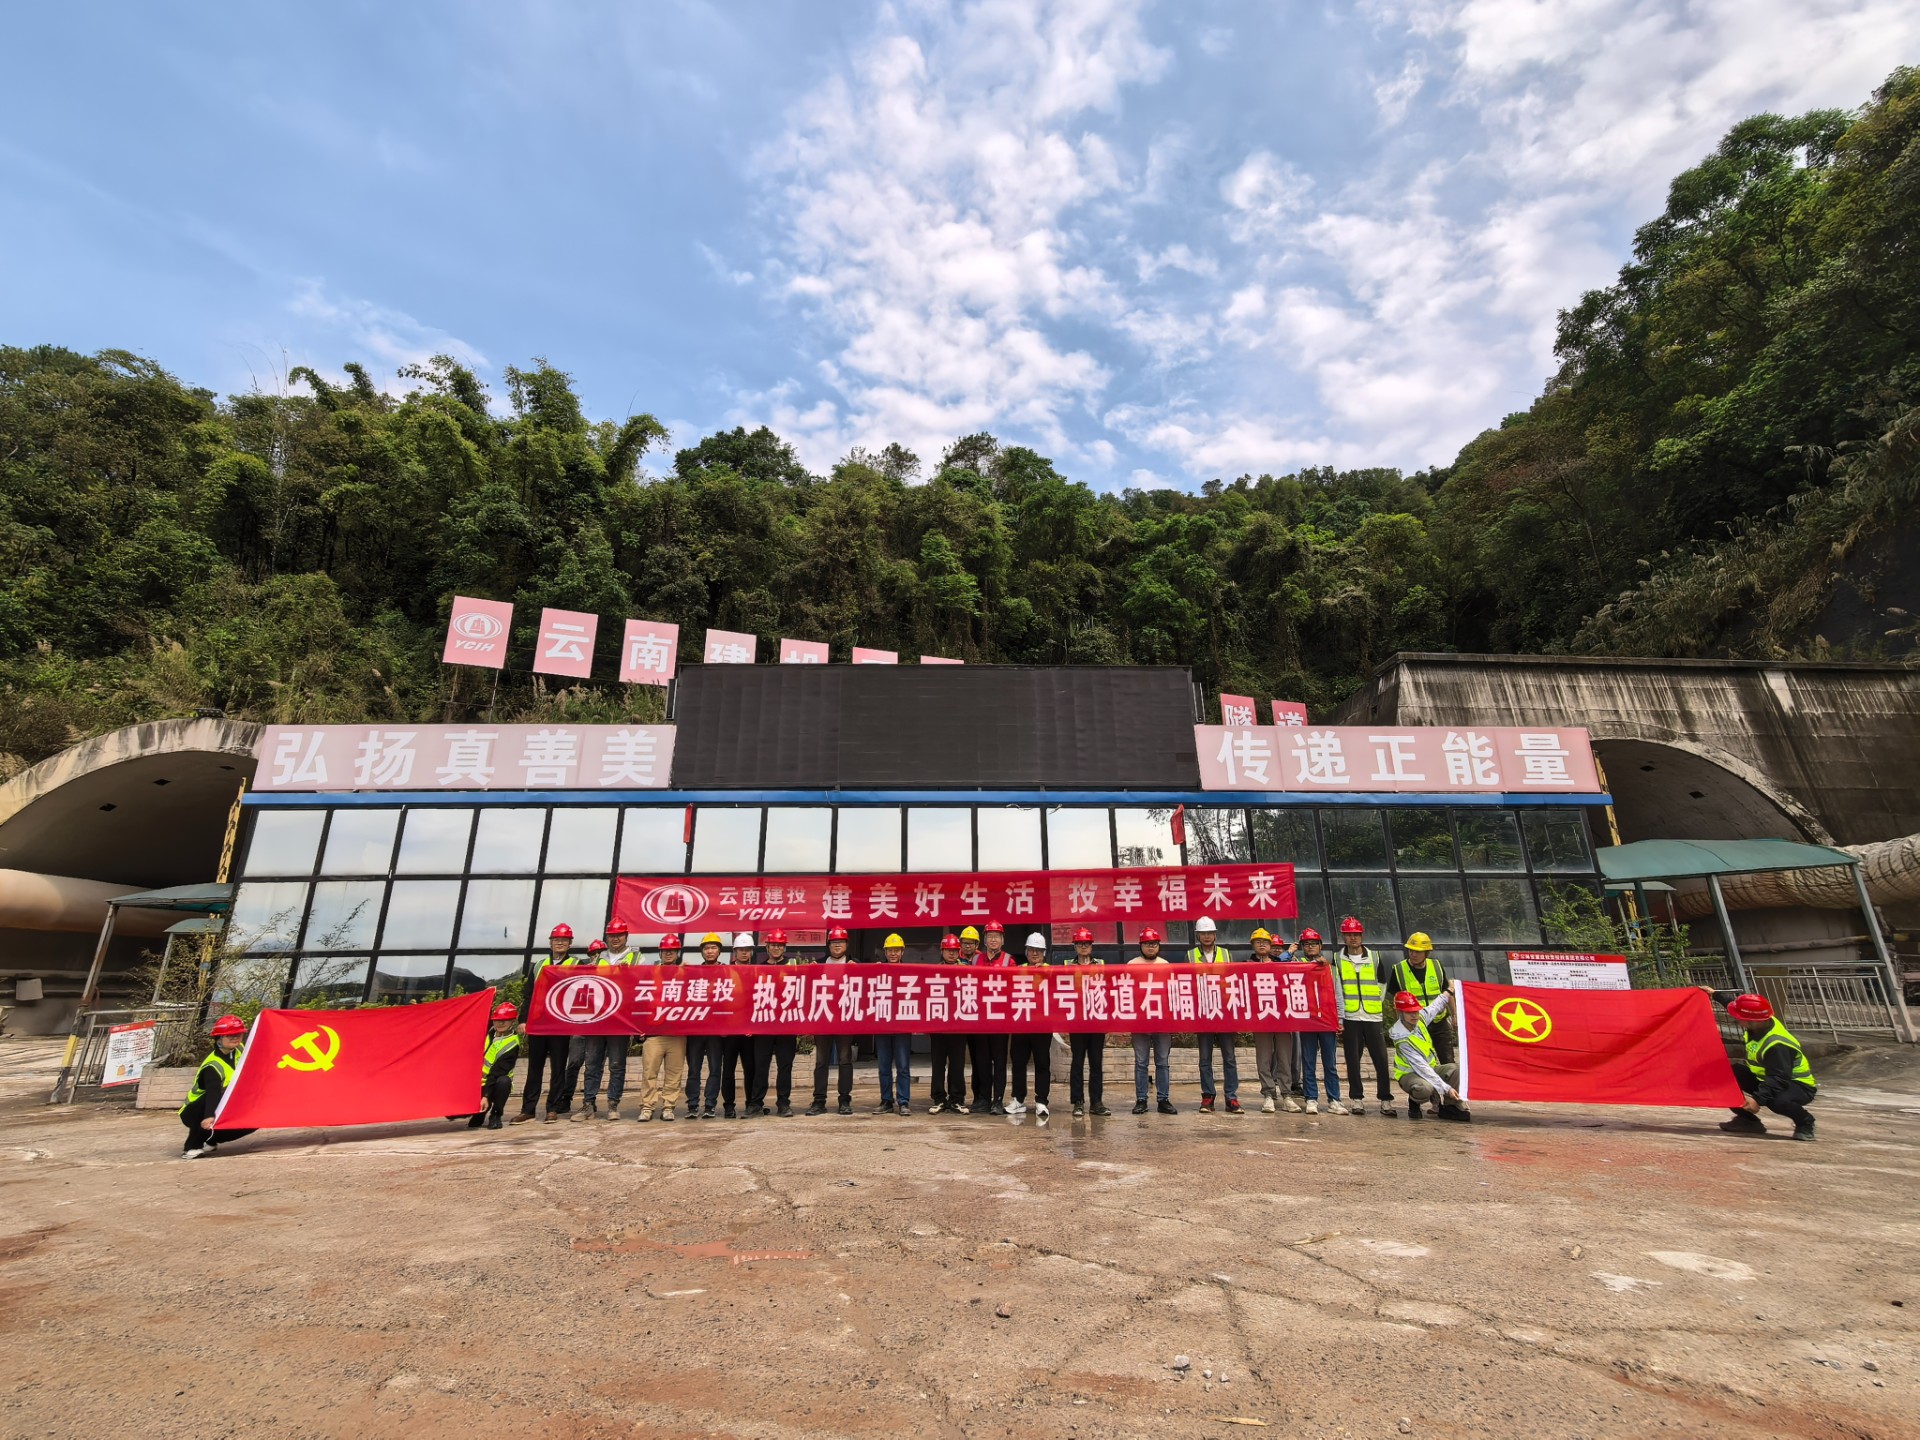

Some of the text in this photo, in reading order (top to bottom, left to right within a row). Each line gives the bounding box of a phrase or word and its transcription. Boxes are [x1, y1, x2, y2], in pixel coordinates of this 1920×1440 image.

[455, 640, 494, 653] YCIH
[271, 729, 658, 787] 弘扬真善美
[1216, 730, 1575, 786] 传递正能量
[719, 871, 1277, 920] 云南建投 建美好生活 投幸福未来
[737, 906, 787, 921] YCIH
[634, 977, 736, 1003] 云南建投
[651, 1006, 711, 1022] YCIH
